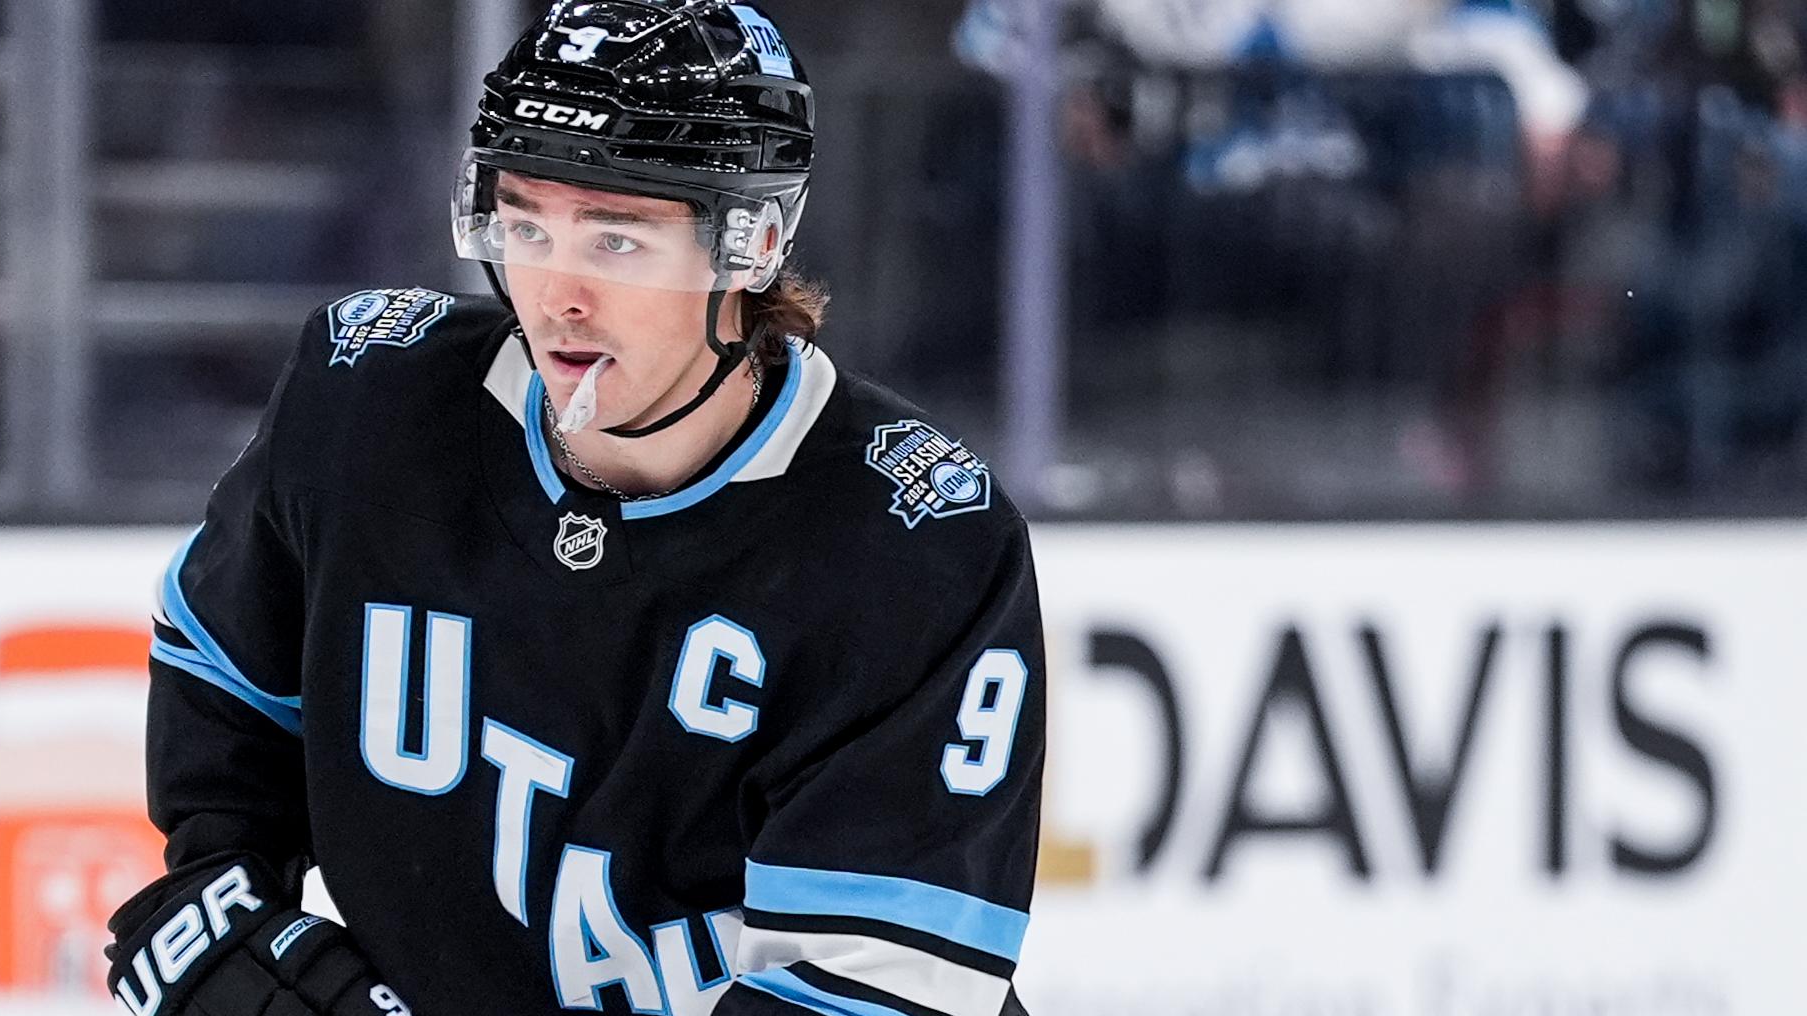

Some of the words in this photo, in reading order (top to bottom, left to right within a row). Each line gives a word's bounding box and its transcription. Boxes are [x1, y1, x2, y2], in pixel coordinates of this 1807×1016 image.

[558, 26, 609, 62] 9
[514, 99, 609, 131] CCM
[368, 289, 427, 339] SEASON
[878, 427, 934, 472] INAUGURAL
[892, 434, 953, 485] SEASON
[903, 480, 929, 506] 2024
[940, 469, 971, 495] UTAH
[563, 531, 596, 555] NHL
[668, 614, 767, 743] C
[939, 647, 1029, 796] 9
[1083, 622, 1719, 878] DAVIS
[275, 923, 303, 950] PRO
